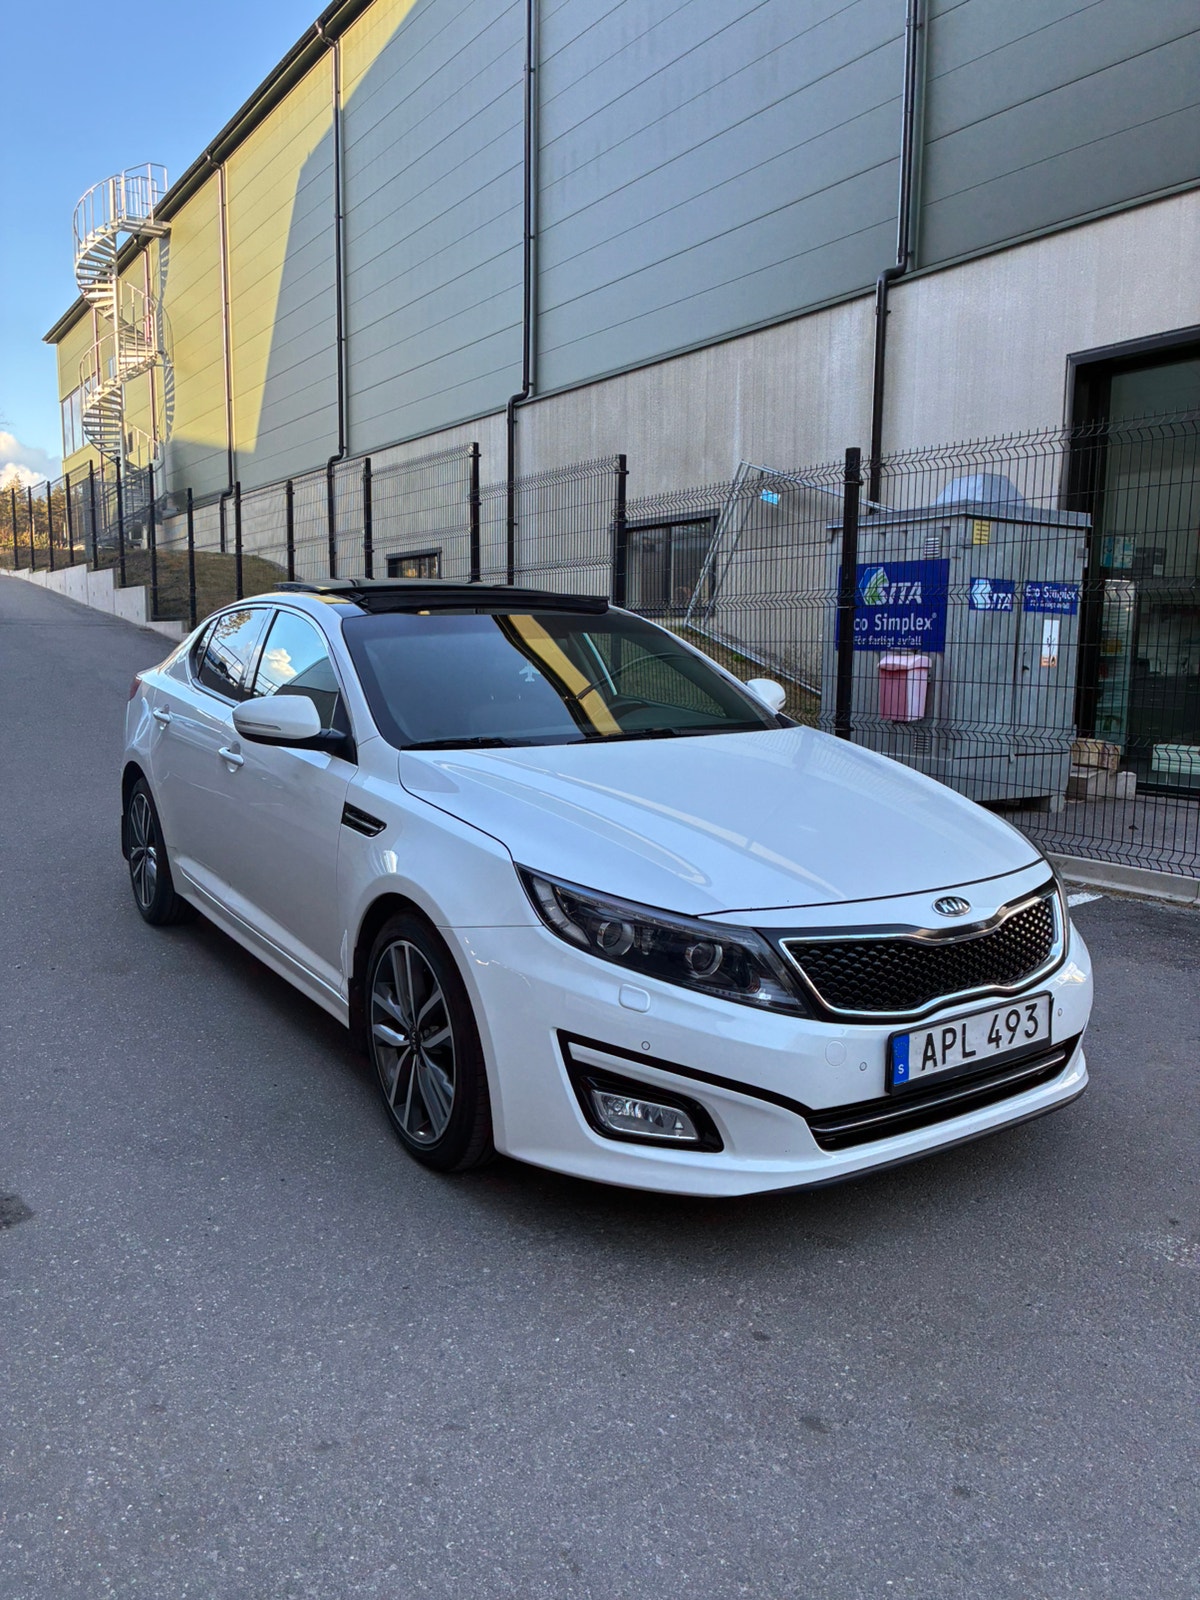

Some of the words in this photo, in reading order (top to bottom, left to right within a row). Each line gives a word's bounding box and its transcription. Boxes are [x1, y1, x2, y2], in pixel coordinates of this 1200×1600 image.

[876, 582, 922, 605] SITA
[1026, 585, 1040, 597] Eo
[854, 618, 868, 631] co
[937, 898, 969, 913] KIA
[898, 1064, 904, 1074] S
[921, 1023, 977, 1071] APL
[987, 1003, 1039, 1049] 493
